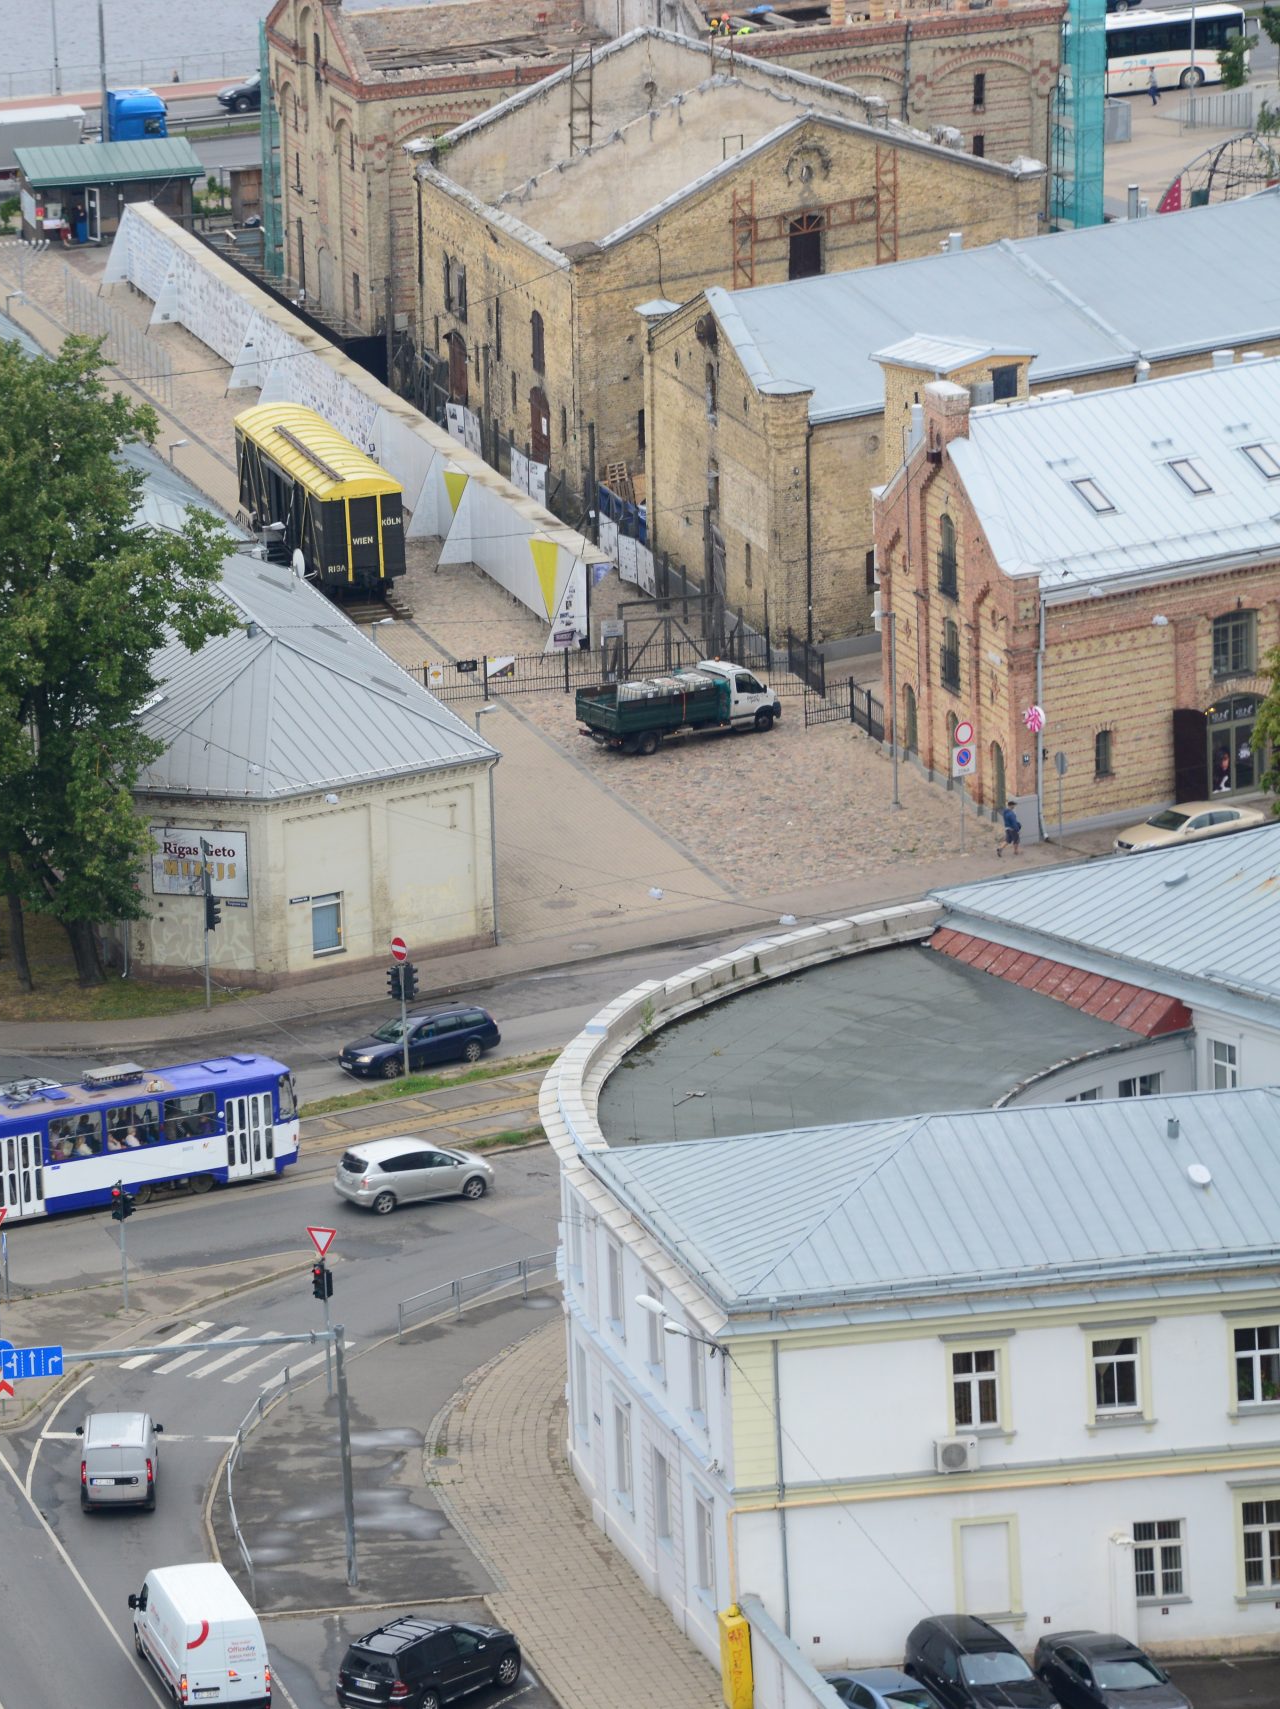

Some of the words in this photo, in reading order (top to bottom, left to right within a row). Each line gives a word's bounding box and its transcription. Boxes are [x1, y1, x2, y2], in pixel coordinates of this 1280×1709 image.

[381, 517, 401, 526] KÖLN
[352, 536, 374, 545] WIEN
[163, 842, 199, 859] Rīgas
